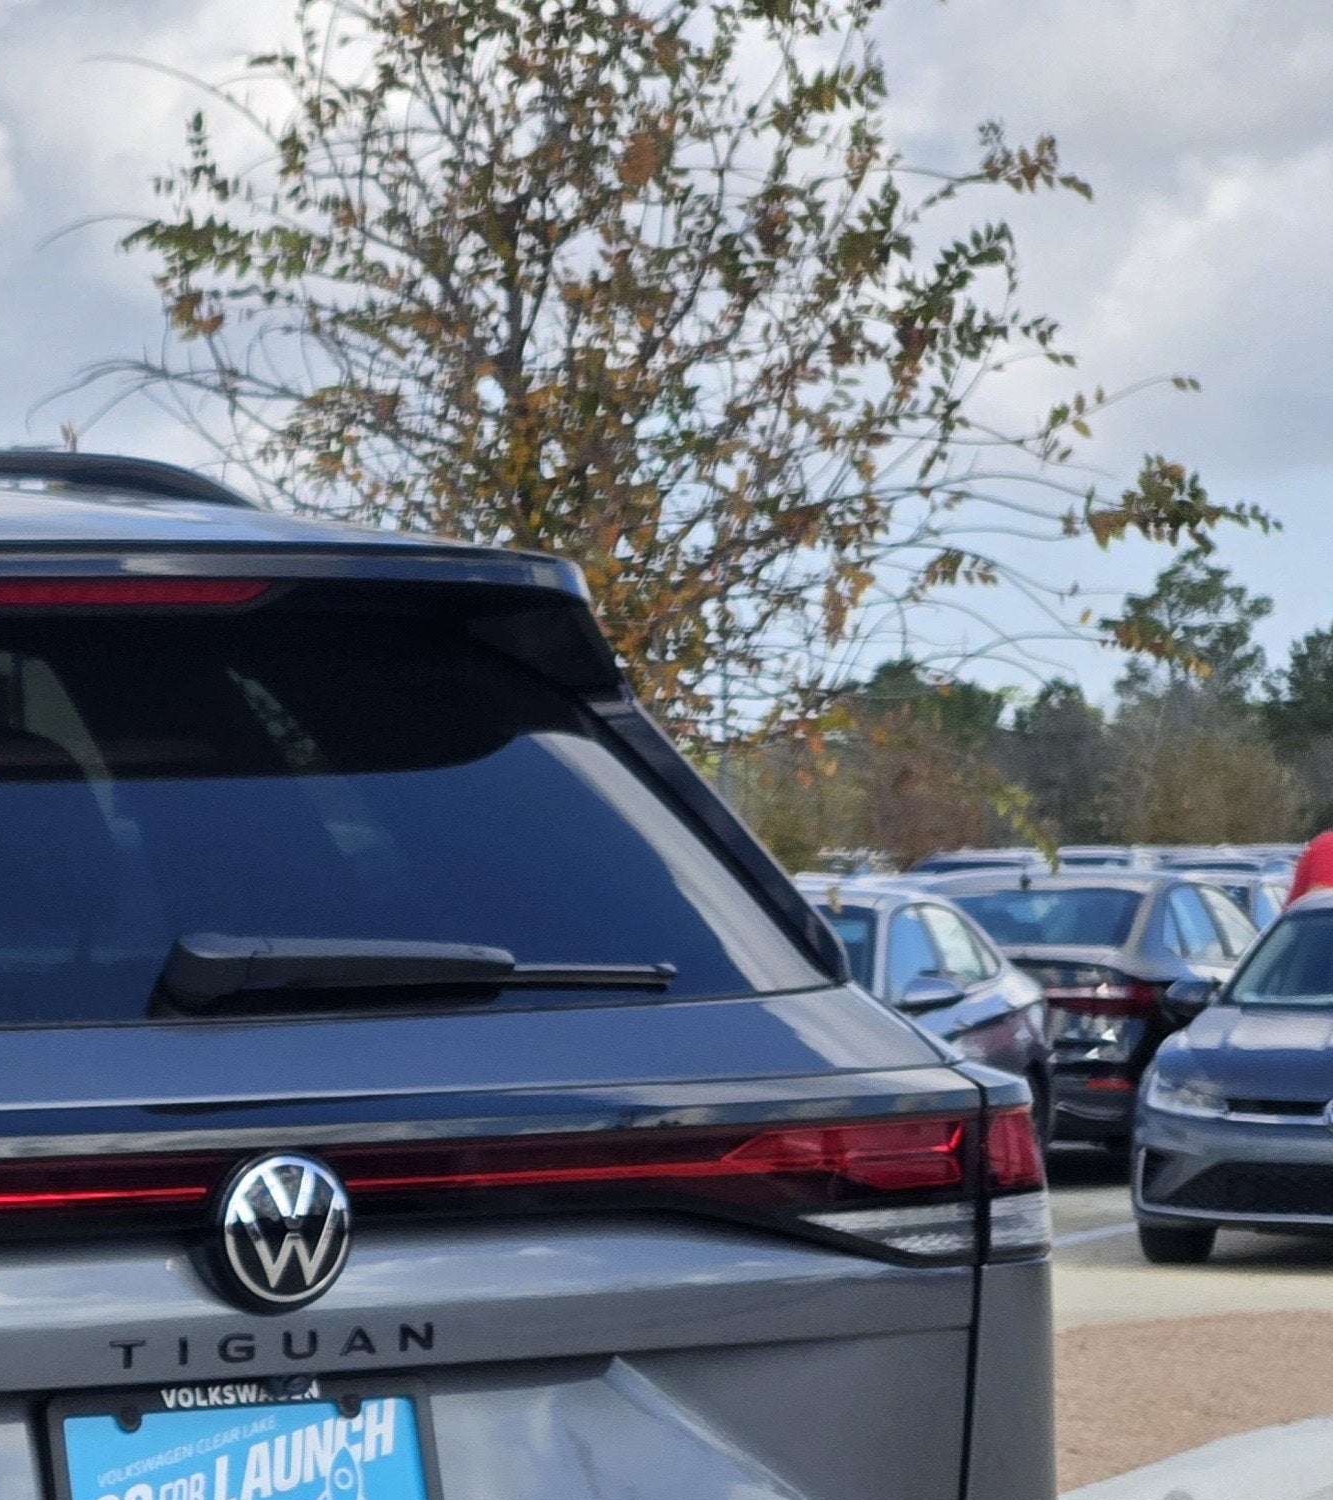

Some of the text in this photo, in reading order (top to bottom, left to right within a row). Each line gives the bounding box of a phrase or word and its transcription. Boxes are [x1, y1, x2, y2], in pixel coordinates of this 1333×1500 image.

[109, 1321, 434, 1370] TIGUAN
[97, 1414, 277, 1488] VOLKSWAGEN CLEAR LAKE
